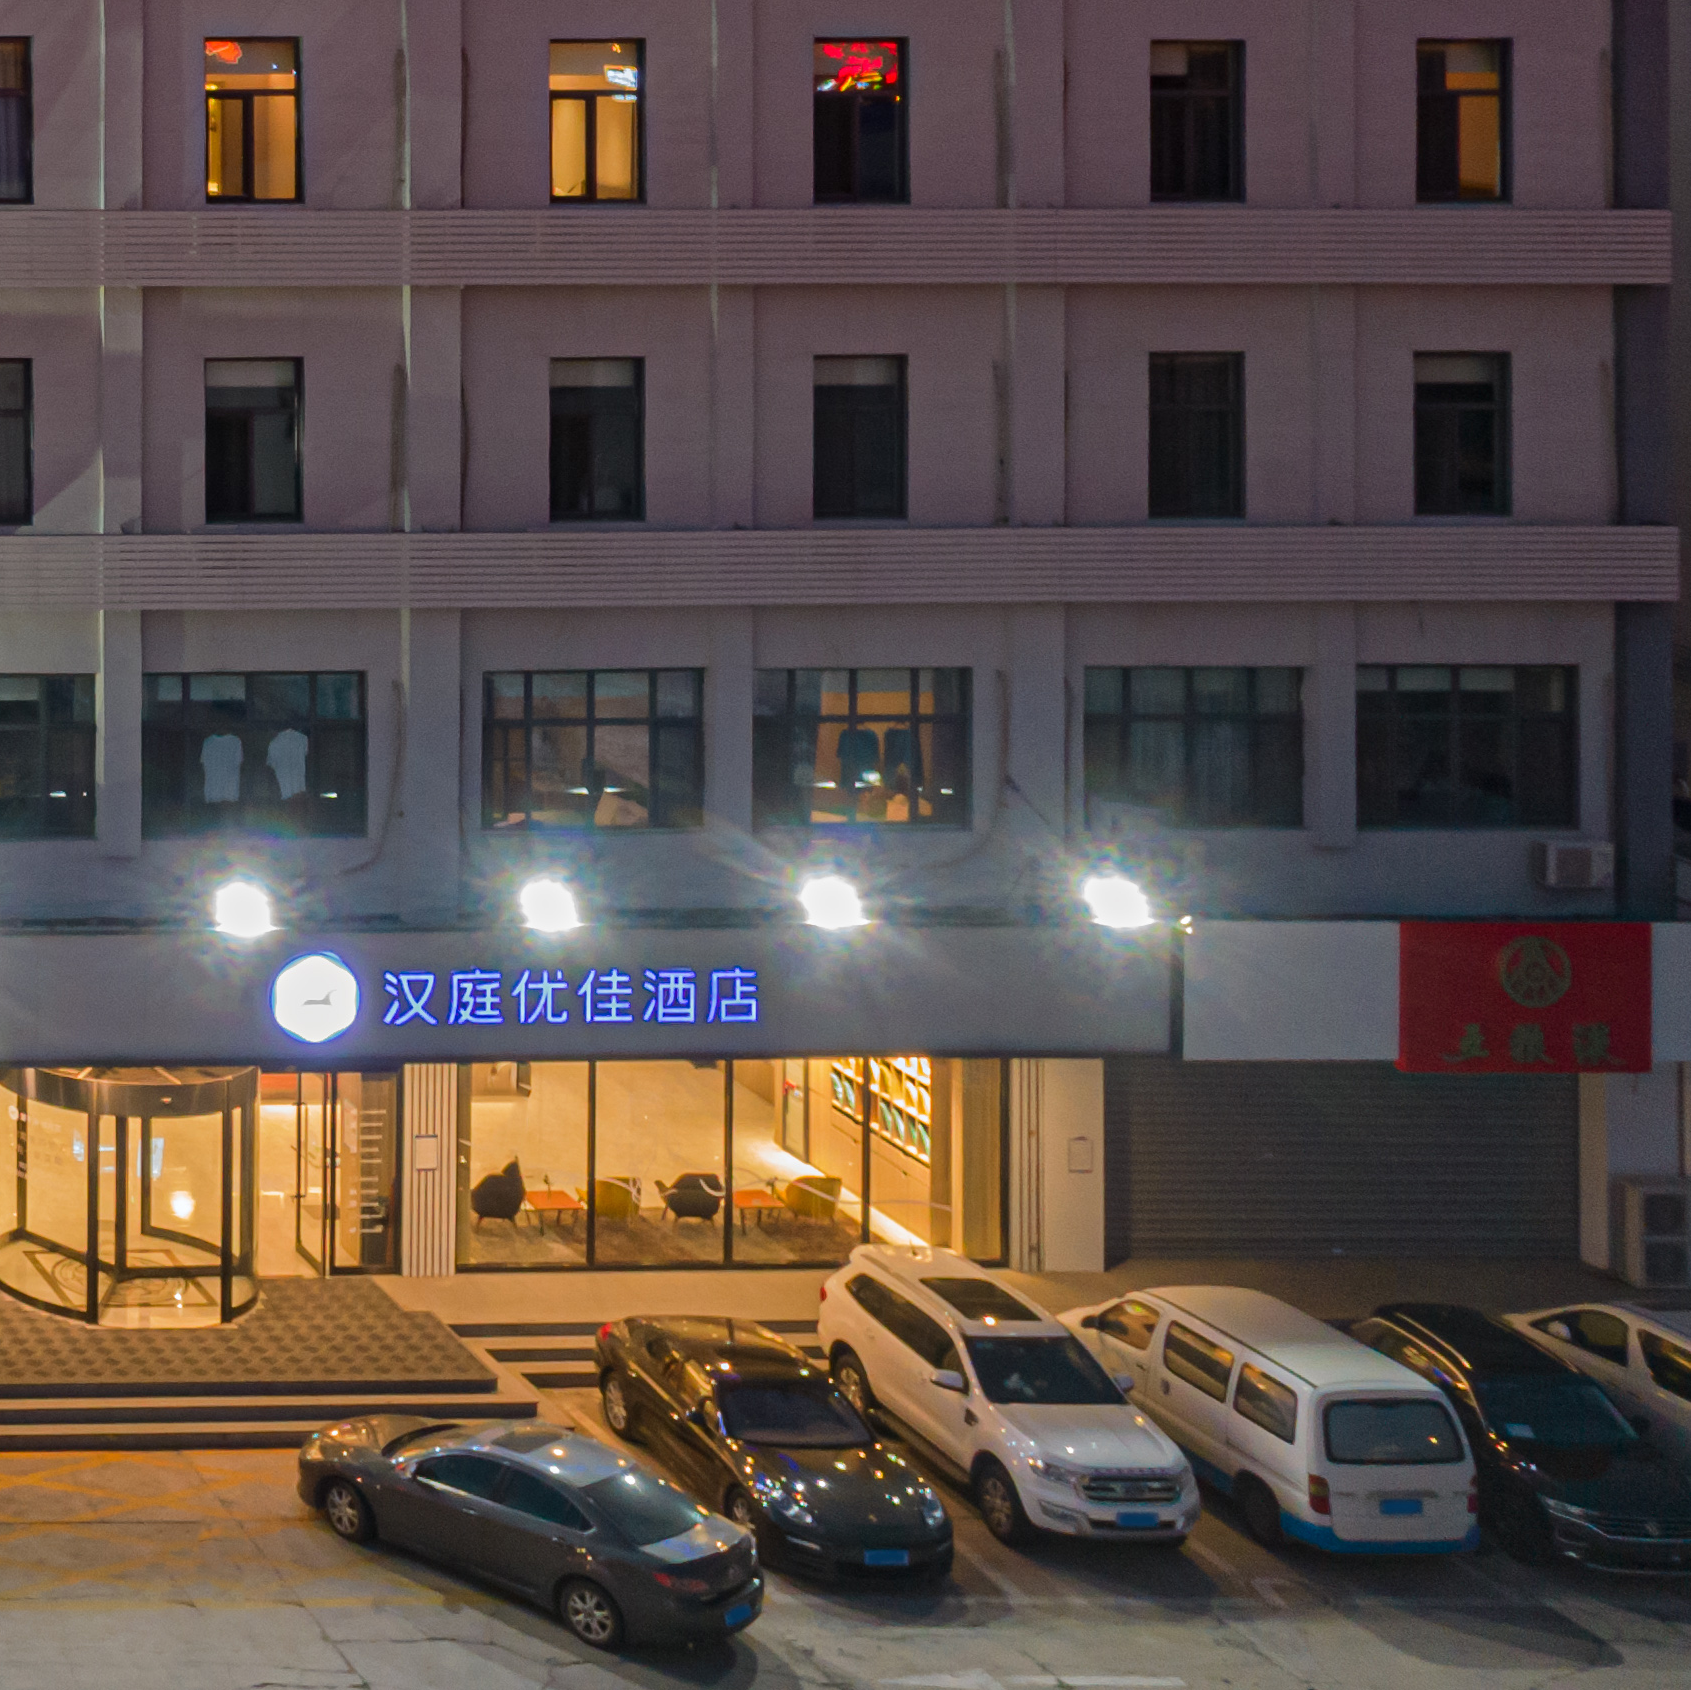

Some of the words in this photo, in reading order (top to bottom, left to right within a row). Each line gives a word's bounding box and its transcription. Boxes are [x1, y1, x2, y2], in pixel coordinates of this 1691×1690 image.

[382, 967, 759, 1026] 汉庭优佳酒店
